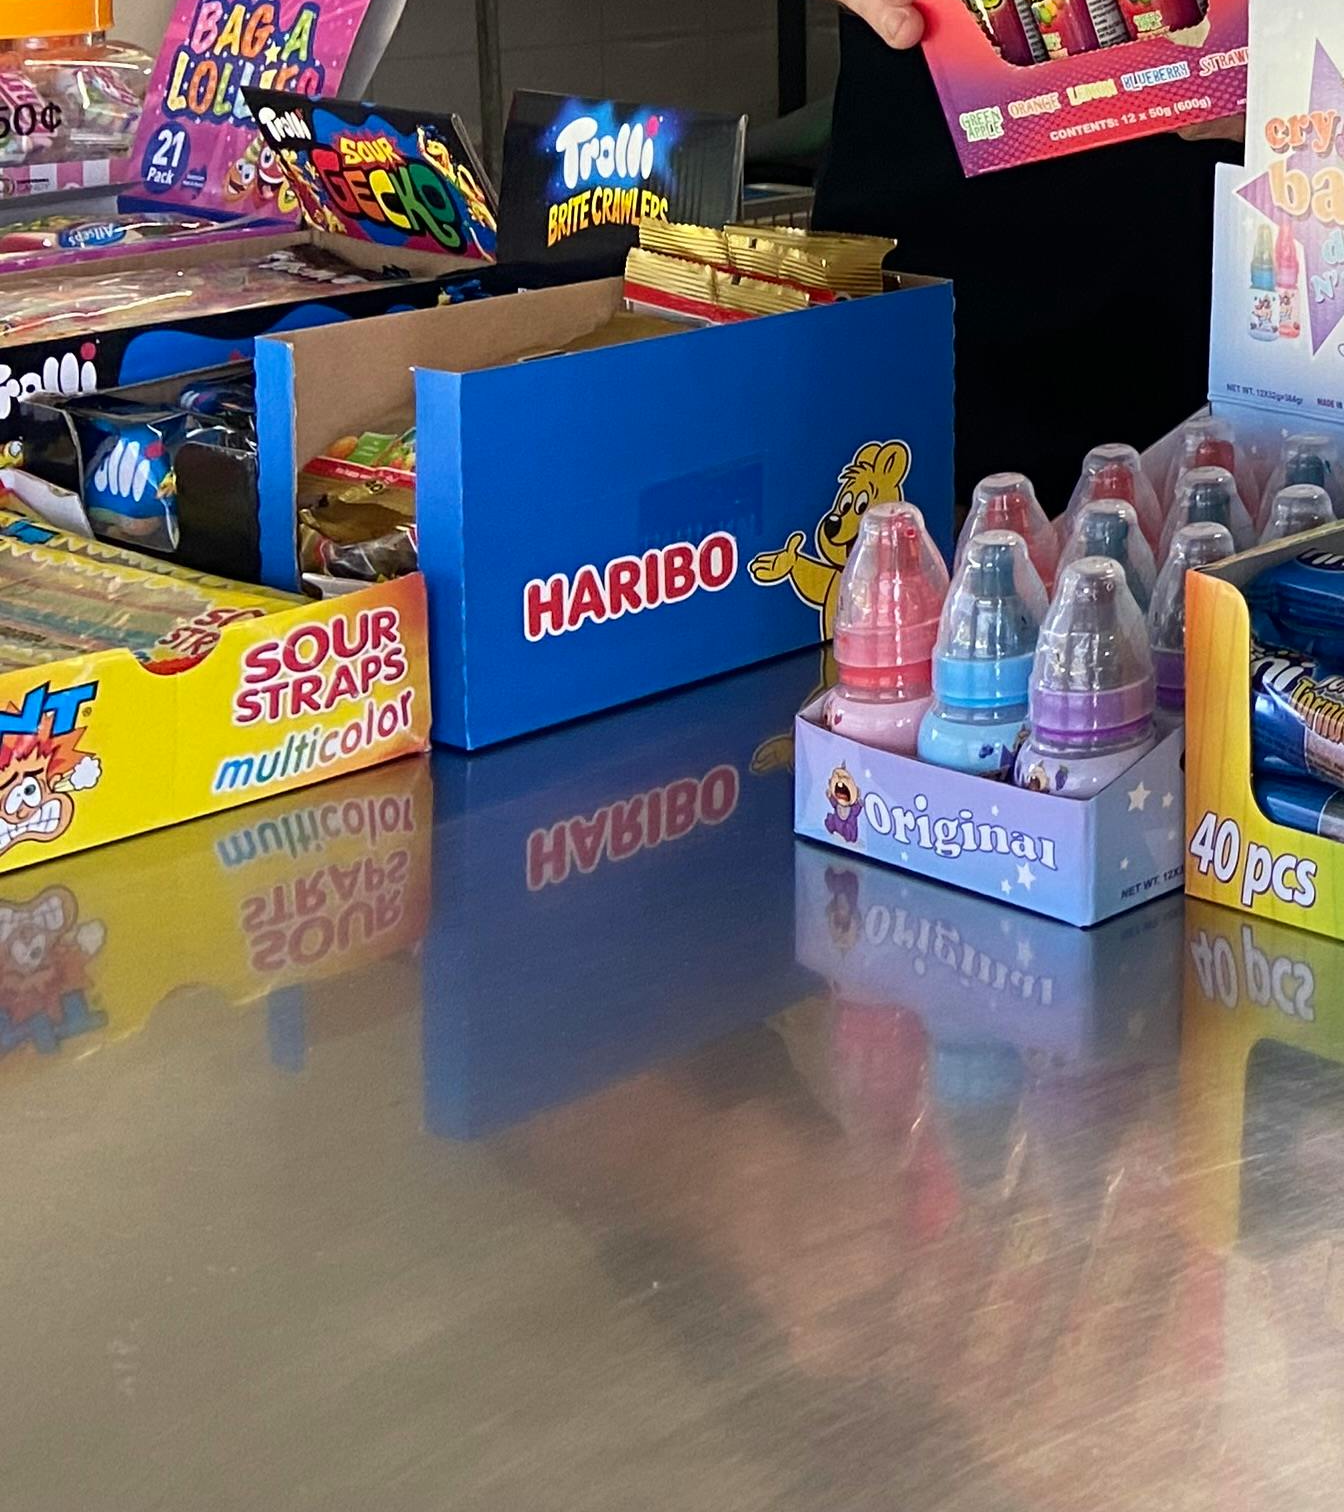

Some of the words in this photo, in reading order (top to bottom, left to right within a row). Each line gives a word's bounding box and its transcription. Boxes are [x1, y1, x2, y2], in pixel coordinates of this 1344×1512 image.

[190, 0, 276, 60] BAG
[281, 7, 319, 62] A
[1122, 63, 1190, 90] BLUEBERRY
[261, 107, 309, 142] Trolli
[961, 108, 1001, 128] GREEN
[1009, 93, 1059, 118] ORANGE
[1050, 118, 1120, 142] CONTENTS:
[1121, 113, 1135, 125] 12
[1138, 112, 1147, 121] x
[1149, 106, 1172, 119] 50g
[1173, 96, 1212, 115] (600g)
[152, 129, 185, 168] 21
[338, 136, 400, 168] SOUR
[556, 115, 665, 189] Trolli
[967, 122, 1002, 140] APPLE
[1264, 111, 1341, 153] cry
[148, 166, 174, 185] Pack
[312, 146, 462, 250] GECKO
[548, 191, 588, 247] BRITE
[526, 532, 739, 641] HARIBO
[243, 608, 399, 686] SOUR
[233, 647, 407, 725] STRAPS
[213, 687, 414, 796] multicolor
[864, 791, 1059, 871] Original
[1188, 811, 1241, 887] 40
[1241, 840, 1319, 912] pcs
[1121, 883, 1141, 900] NET
